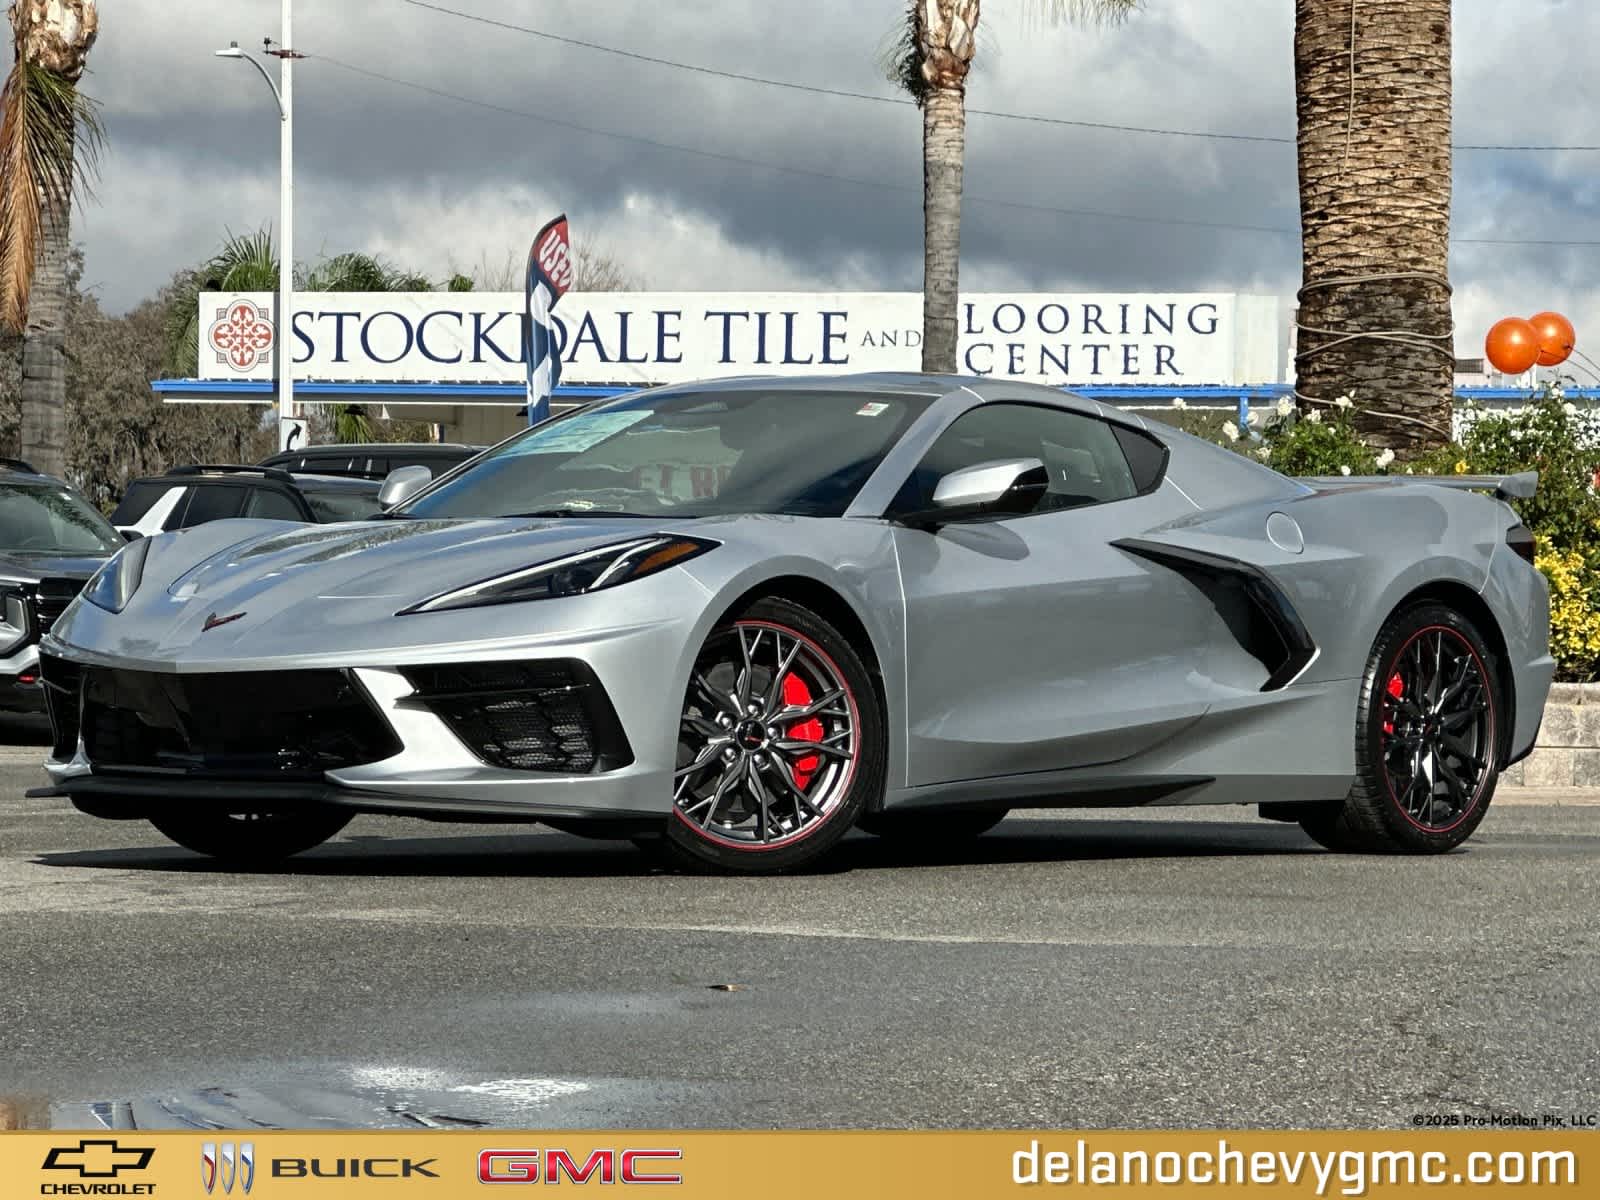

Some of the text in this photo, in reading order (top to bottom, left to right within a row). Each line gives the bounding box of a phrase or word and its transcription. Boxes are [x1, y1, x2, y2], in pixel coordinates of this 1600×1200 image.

[962, 302, 1220, 336] LOORING
[703, 310, 850, 365] TILE
[860, 329, 922, 348] AND
[964, 342, 1183, 376] CENTER
